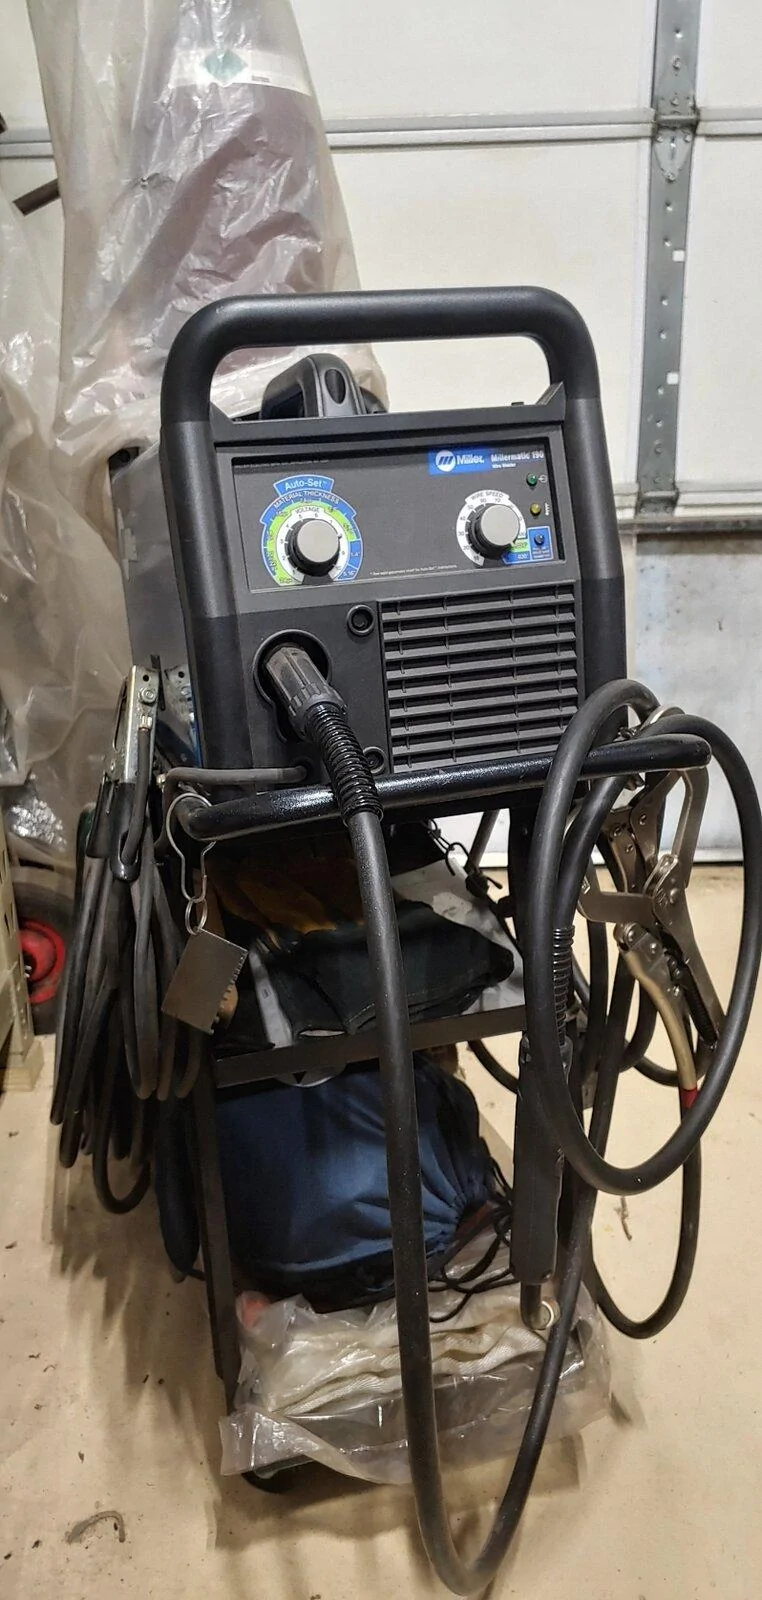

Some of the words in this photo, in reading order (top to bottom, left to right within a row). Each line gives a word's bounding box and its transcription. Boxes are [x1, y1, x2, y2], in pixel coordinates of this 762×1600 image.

[273, 490, 303, 508] MATERIAL
[303, 490, 341, 505] THICKNESS
[295, 506, 320, 515] VOLTAGE
